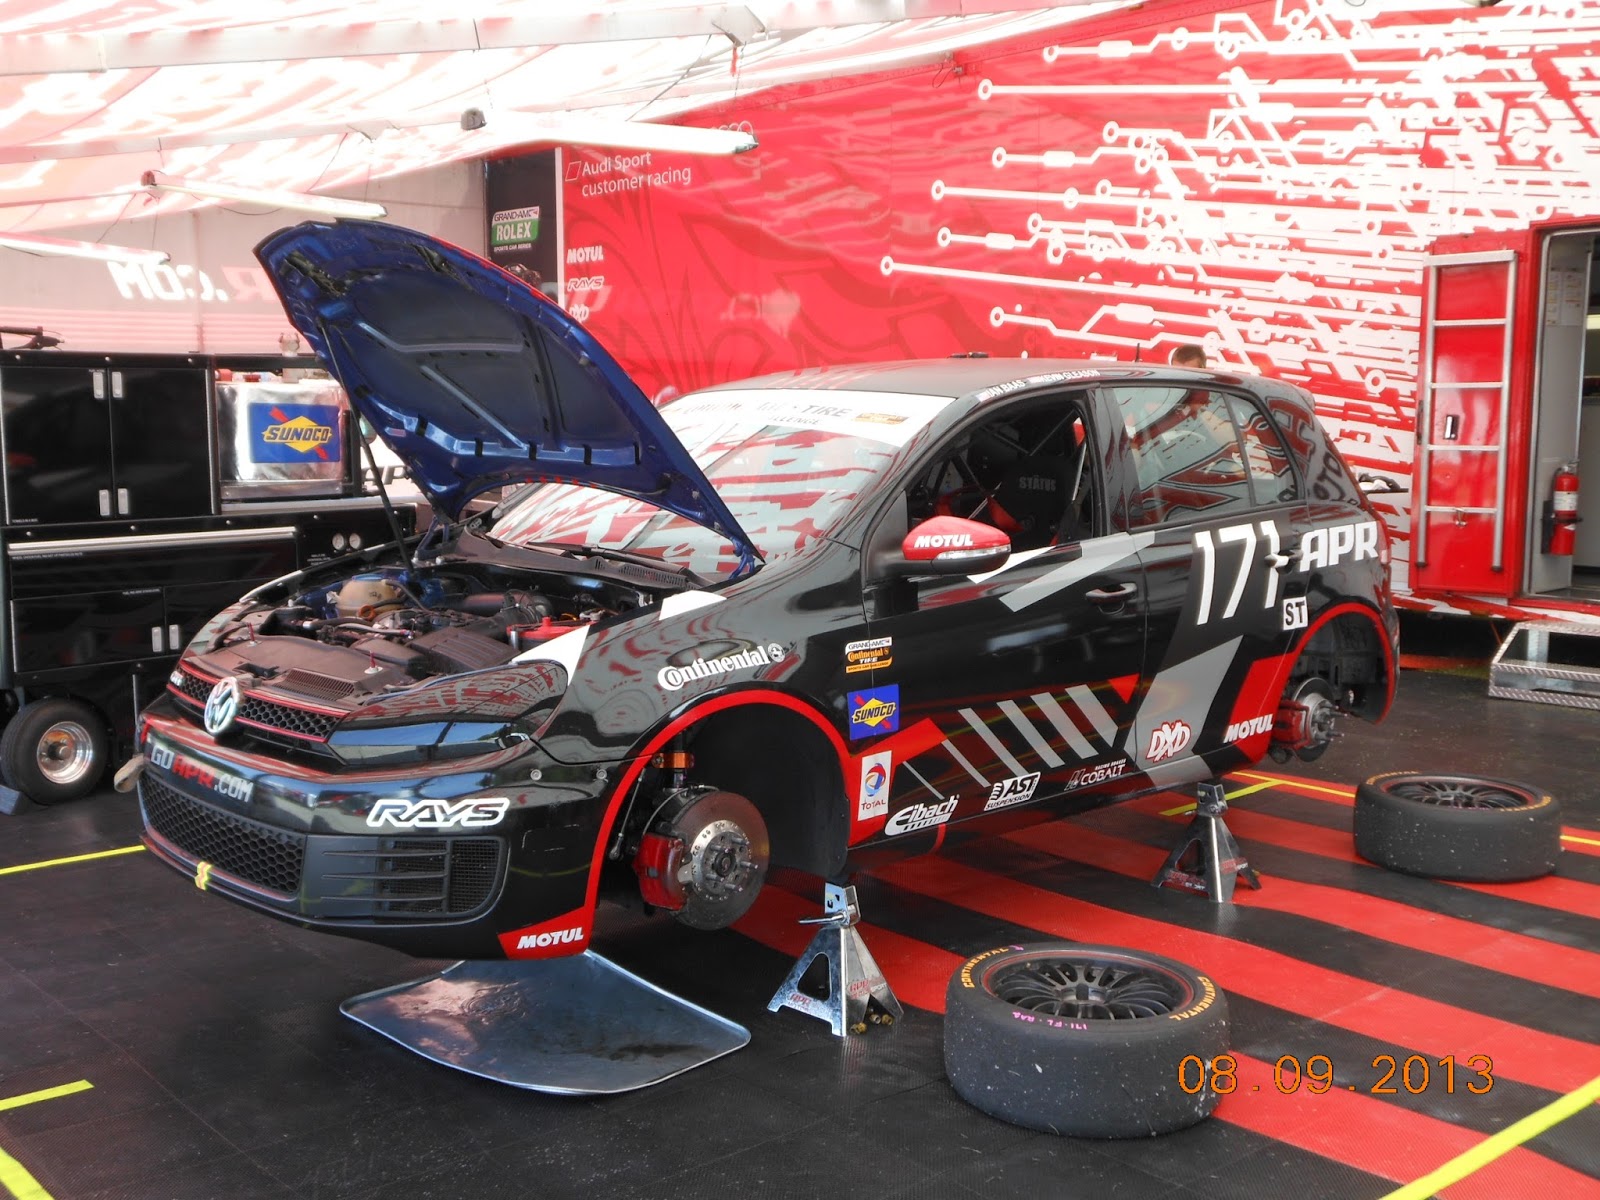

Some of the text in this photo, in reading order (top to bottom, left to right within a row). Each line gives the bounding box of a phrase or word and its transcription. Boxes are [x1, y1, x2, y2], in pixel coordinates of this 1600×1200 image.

[582, 152, 652, 176] Audi Sport
[582, 166, 692, 197] customer racing
[496, 222, 532, 241] ROLEX
[567, 245, 604, 263] MOTUL
[567, 276, 604, 291] RAYS
[1001, 379, 1026, 393] BAAS
[1064, 369, 1100, 380] GLEASON
[801, 405, 852, 418] TIRE
[266, 426, 331, 442] SUNOCO
[914, 534, 974, 548] MOTUL
[1300, 520, 1379, 572] APR
[1194, 519, 1287, 626] 171
[1285, 599, 1307, 626] ST
[657, 645, 771, 691] Continental
[854, 703, 895, 722] SUNOCO
[1223, 713, 1273, 743] MOTUL
[1147, 720, 1191, 763] DXD
[1003, 774, 1039, 798] AST
[1080, 764, 1126, 786] COBALT
[366, 797, 510, 828] RAYS
[985, 792, 1032, 810] SUSPENSION
[517, 928, 584, 949] MOTUL
